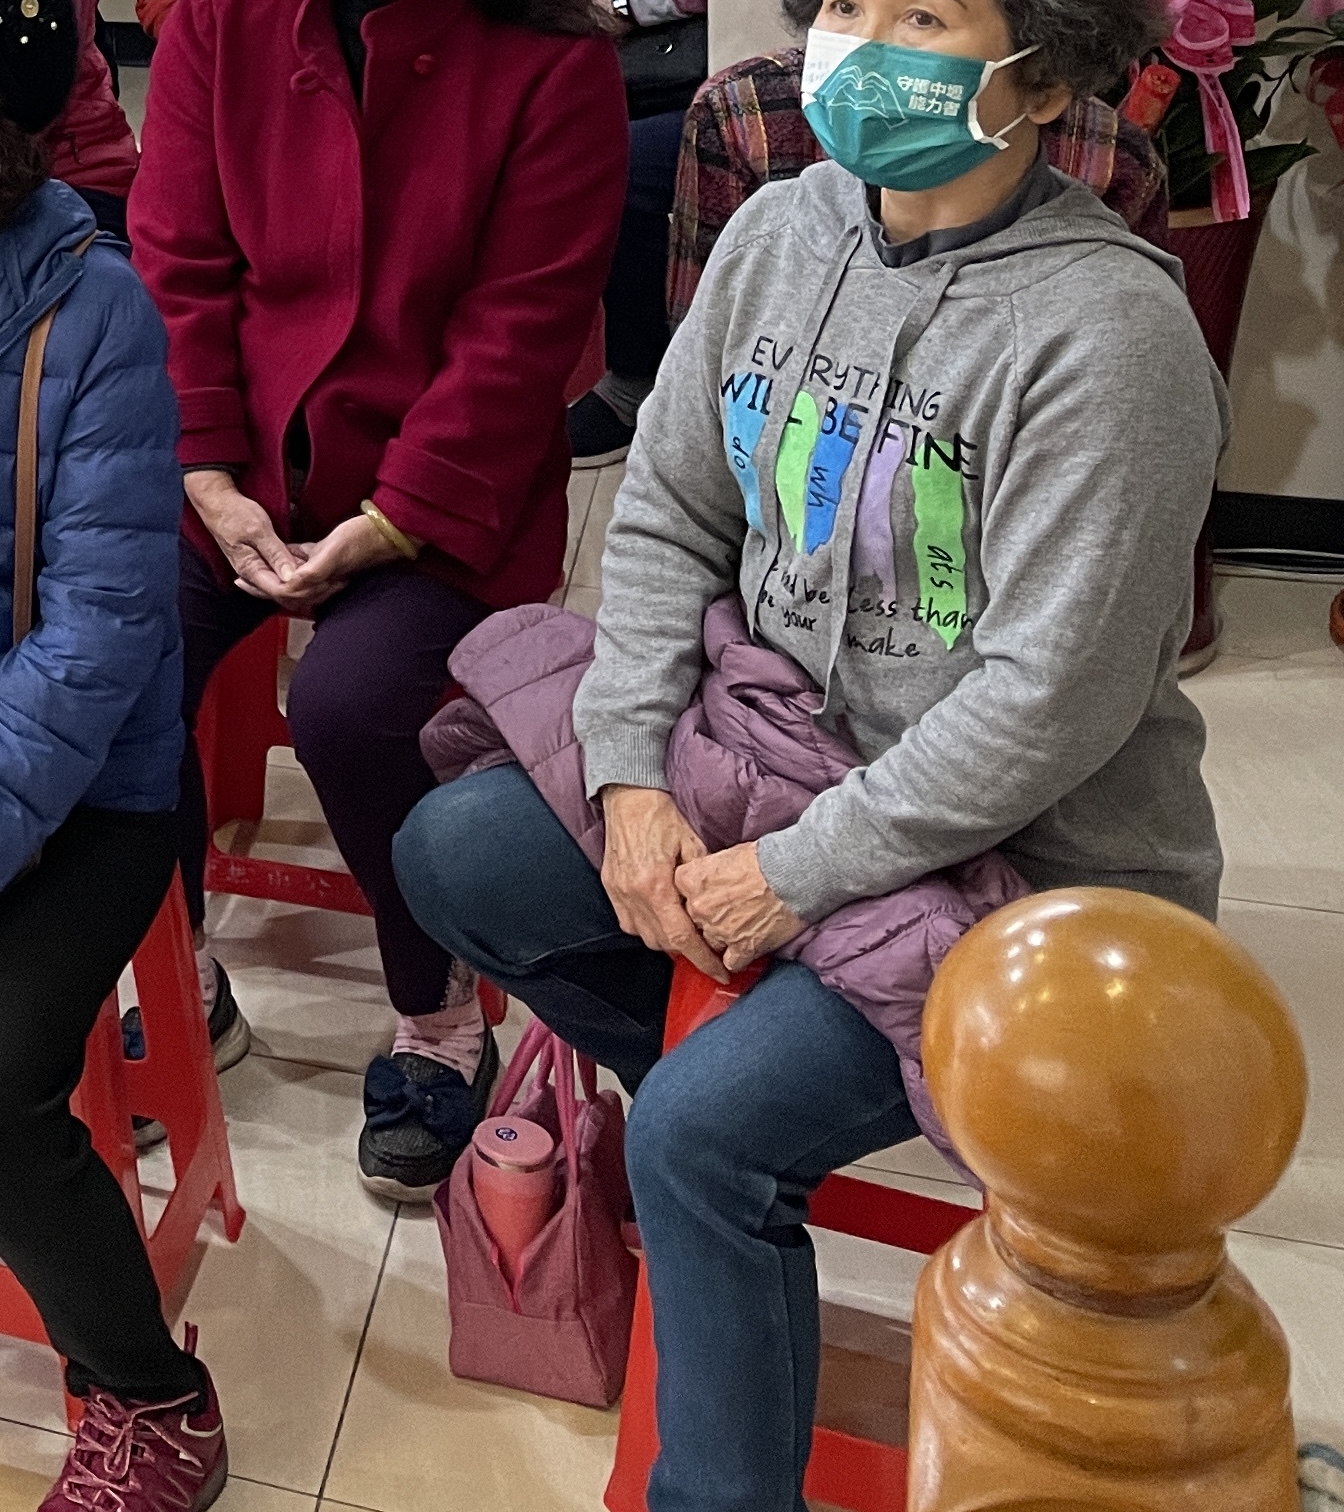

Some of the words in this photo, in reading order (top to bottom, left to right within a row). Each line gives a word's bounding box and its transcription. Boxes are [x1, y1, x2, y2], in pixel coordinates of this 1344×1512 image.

[751, 335, 940, 422] EVRYTHING
[821, 396, 870, 443] BE
[877, 419, 979, 481] FINE
